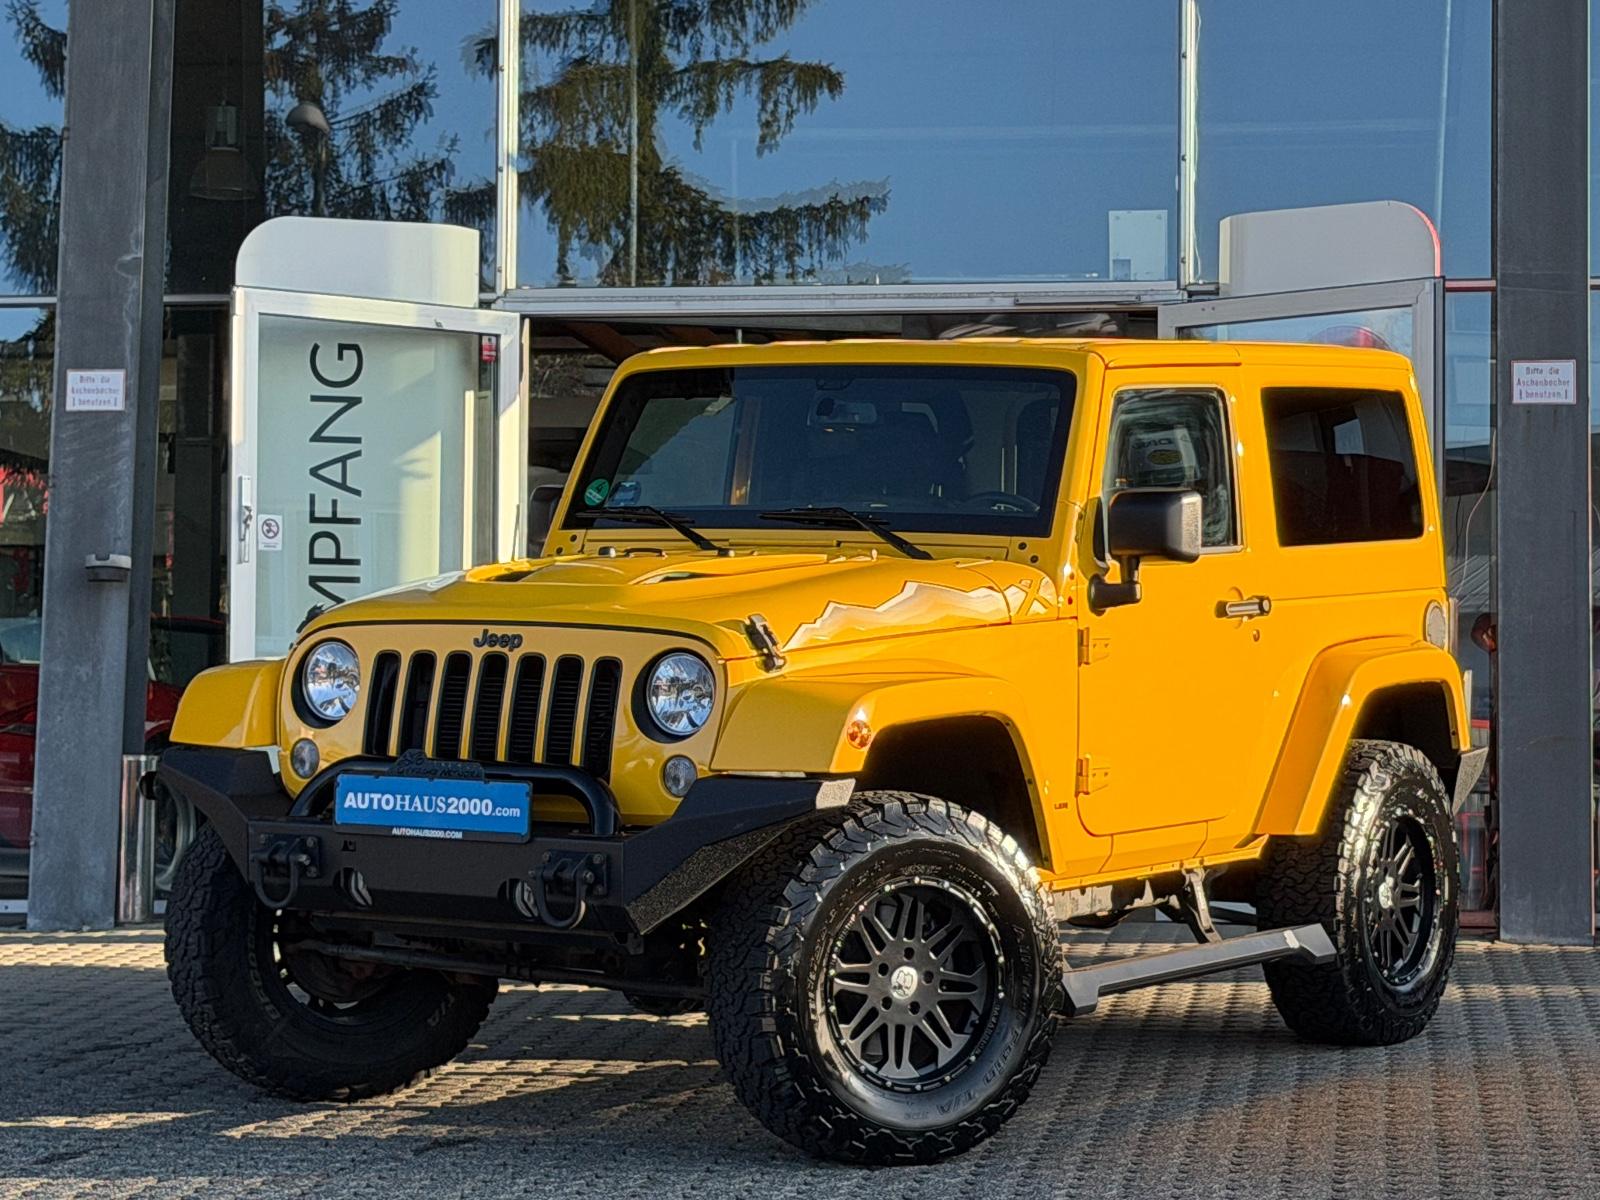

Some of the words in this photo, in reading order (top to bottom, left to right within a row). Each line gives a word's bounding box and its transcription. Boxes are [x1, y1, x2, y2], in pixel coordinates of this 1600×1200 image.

[473, 628, 523, 652] Jeep
[344, 791, 521, 818] AUTOHAUS2000.com
[391, 827, 463, 839] AUTOHAUS2000.COM
